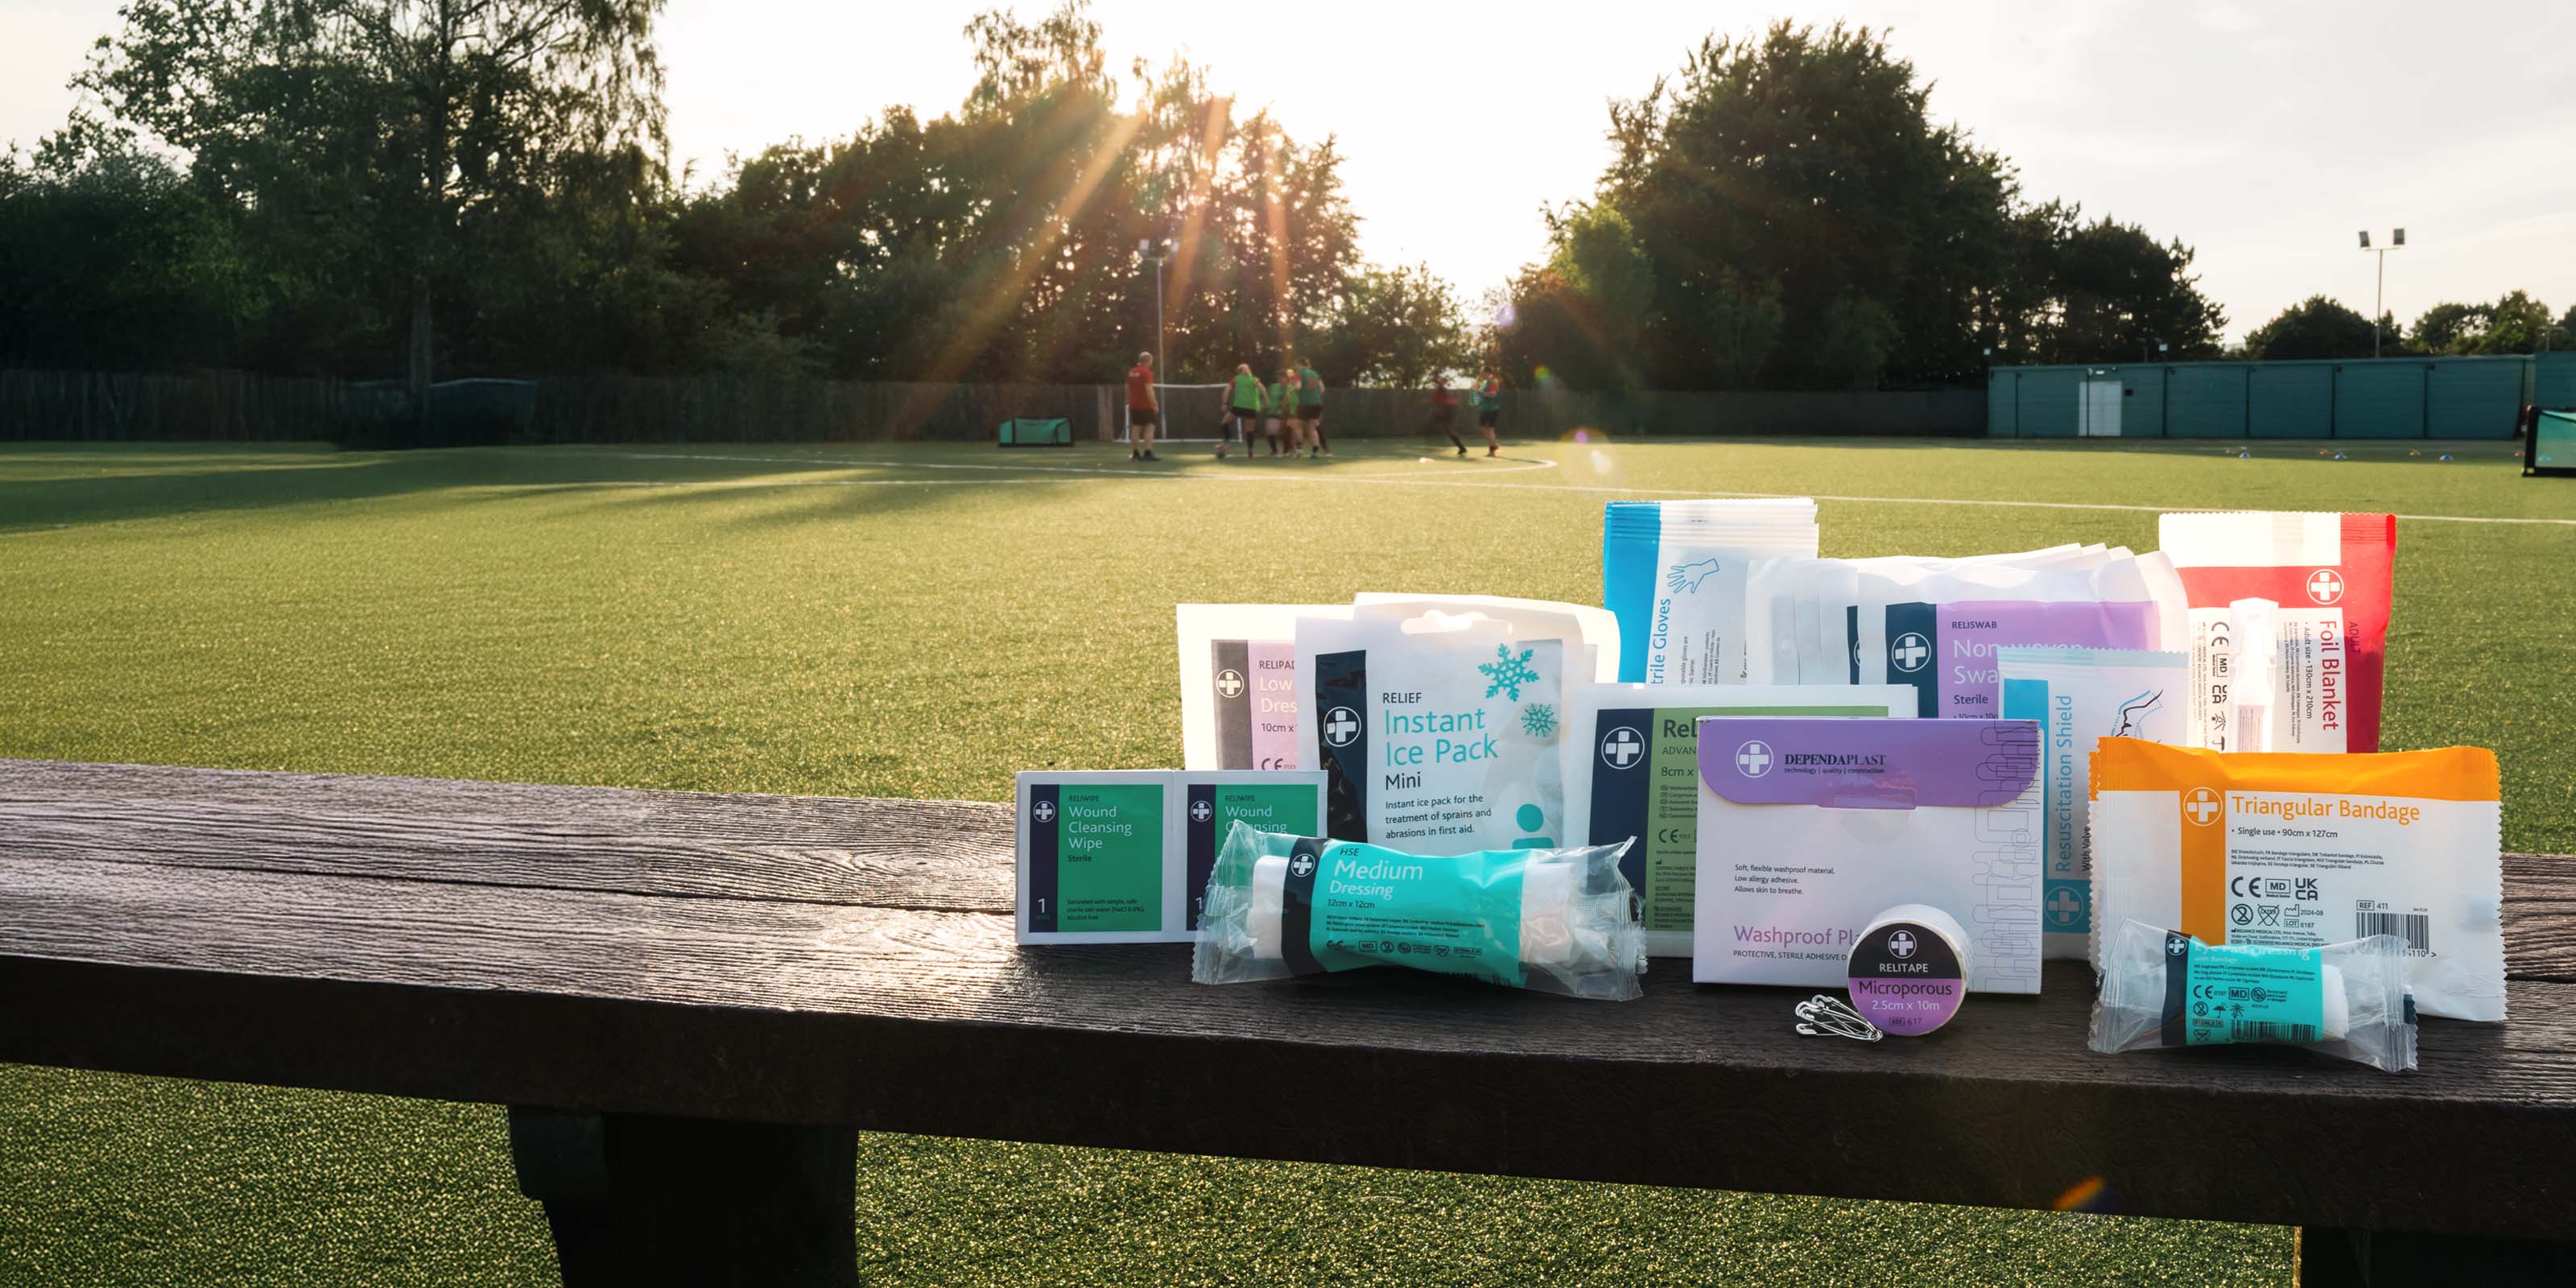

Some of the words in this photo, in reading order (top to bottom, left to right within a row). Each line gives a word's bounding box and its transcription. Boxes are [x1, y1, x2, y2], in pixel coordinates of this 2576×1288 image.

[1652, 598, 1670, 650] Gloves
[2304, 627, 2312, 648] Adult
[2319, 621, 2340, 653] Foil
[2349, 621, 2362, 654] ADULT
[2219, 658, 2227, 673] MD
[1260, 676, 1293, 691] Low
[1382, 692, 1422, 704] RELIEF
[1954, 694, 1988, 704] Sterile
[2322, 658, 2343, 730] Blanket
[1261, 698, 1298, 713] Dres
[1261, 723, 1286, 733] 10cm
[1385, 708, 1486, 735] Instant
[2055, 696, 2073, 748] Shield
[1386, 742, 1424, 766] Ice
[1435, 733, 1499, 764] Pack
[1662, 746, 1697, 754] ADVAN
[1785, 753, 1885, 765] DEPENDAPLAST
[1661, 766, 1684, 777] 8cm
[1686, 769, 1694, 777] x
[1385, 771, 1422, 791] Mini
[1385, 800, 1415, 809] Instant
[1417, 799, 1429, 807] ice
[1431, 796, 1451, 807] pack
[1454, 795, 1466, 804] for
[1468, 794, 1484, 803] the
[1068, 806, 1117, 818] Wound
[1225, 805, 1273, 817] Wound
[1385, 814, 1429, 824] treatment
[1430, 811, 1440, 820] of
[1443, 810, 1473, 822] sprains
[1476, 808, 1492, 817] and
[2055, 753, 2073, 872] Resuscitation
[2232, 795, 2333, 820] Triangular
[2339, 799, 2421, 825] Bandage
[1068, 821, 1133, 836] Cleansing
[1385, 829, 1426, 839] abrasions
[1428, 827, 1437, 836] in
[1439, 826, 1457, 835] first
[1459, 824, 1475, 834] aid.
[1658, 829, 1679, 843] CE
[2238, 828, 2260, 836] Single
[2282, 829, 2305, 837] 90cm
[2312, 830, 2338, 838] 127cm
[1068, 837, 1104, 852] Wipe
[2081, 826, 2091, 849] Valve
[1340, 848, 1360, 857] HSE
[1750, 864, 1773, 872] flexible
[1773, 865, 1807, 873] washproof
[2081, 851, 2091, 871] With
[1334, 859, 1423, 880] Medium
[1748, 876, 1769, 884] allergy
[2231, 876, 2261, 898] CE
[2269, 882, 2286, 890] MD
[2295, 877, 2318, 889] UK
[1330, 880, 1394, 900] Dressing
[1778, 887, 1804, 895] breathe.
[2295, 890, 2318, 901] CA
[1038, 898, 1046, 914] 1
[1327, 899, 1347, 908] 12cm
[1355, 900, 1375, 909] 12cm
[1734, 925, 1833, 948] Washproof
[1733, 950, 1777, 959] PROTECTIVE,
[1778, 952, 1804, 960] STERILE
[1880, 964, 1929, 973] RELITAPE
[1860, 980, 1952, 998] Microporous
[2194, 985, 2214, 999] CE
[2231, 989, 2248, 998] MD
[1872, 1000, 1904, 1010] 2.5cm
[1918, 1000, 1940, 1011] 10m
